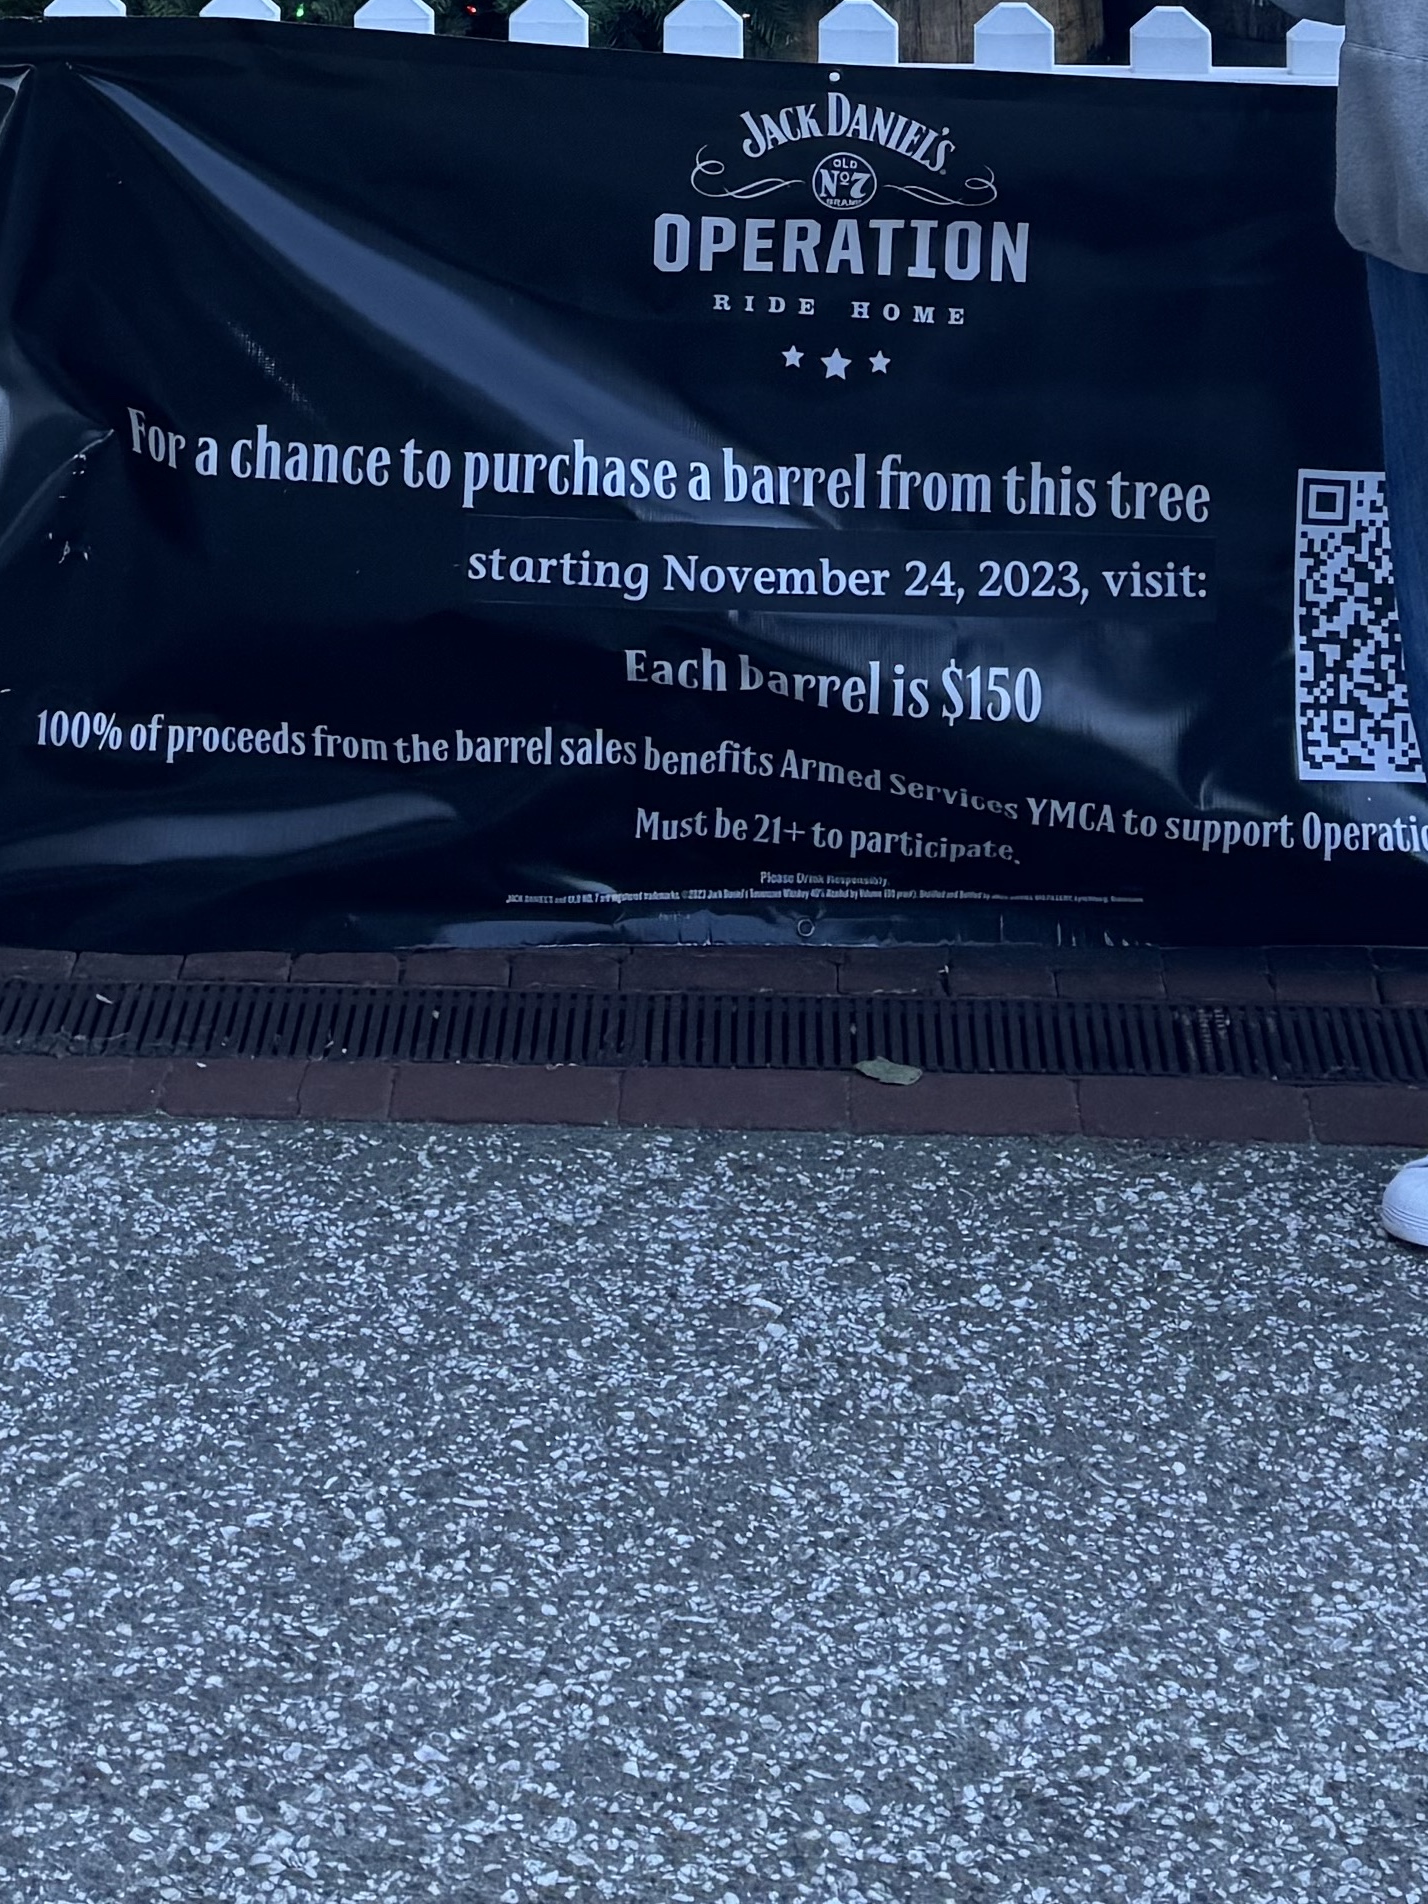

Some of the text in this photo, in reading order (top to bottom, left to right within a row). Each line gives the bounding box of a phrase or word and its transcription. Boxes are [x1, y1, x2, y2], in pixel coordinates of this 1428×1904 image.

[740, 92, 955, 175] JACK DANIEL'S
[833, 158, 858, 169] OLD
[653, 212, 1031, 284] OPERATION
[713, 294, 965, 325] RIDE HOME
[127, 406, 1211, 523] For a chance to purchase a barrel from this tree
[467, 548, 1209, 605] starting November 24, 2023, visit:
[625, 648, 1042, 726] Each barrel is $150
[36, 709, 122, 751] 100%
[130, 713, 165, 753] of
[166, 722, 306, 764] proceeds
[311, 724, 388, 761] from
[392, 733, 449, 764] the
[455, 726, 553, 765] barrel
[559, 728, 637, 766] sales
[644, 735, 774, 776] benefits
[779, 749, 882, 792] Armed
[889, 773, 1019, 820] Services
[1025, 797, 1116, 834] YMCA
[1122, 808, 1157, 837] to
[1164, 814, 1294, 853] support
[635, 807, 1021, 865] Must be 21+ to participate.
